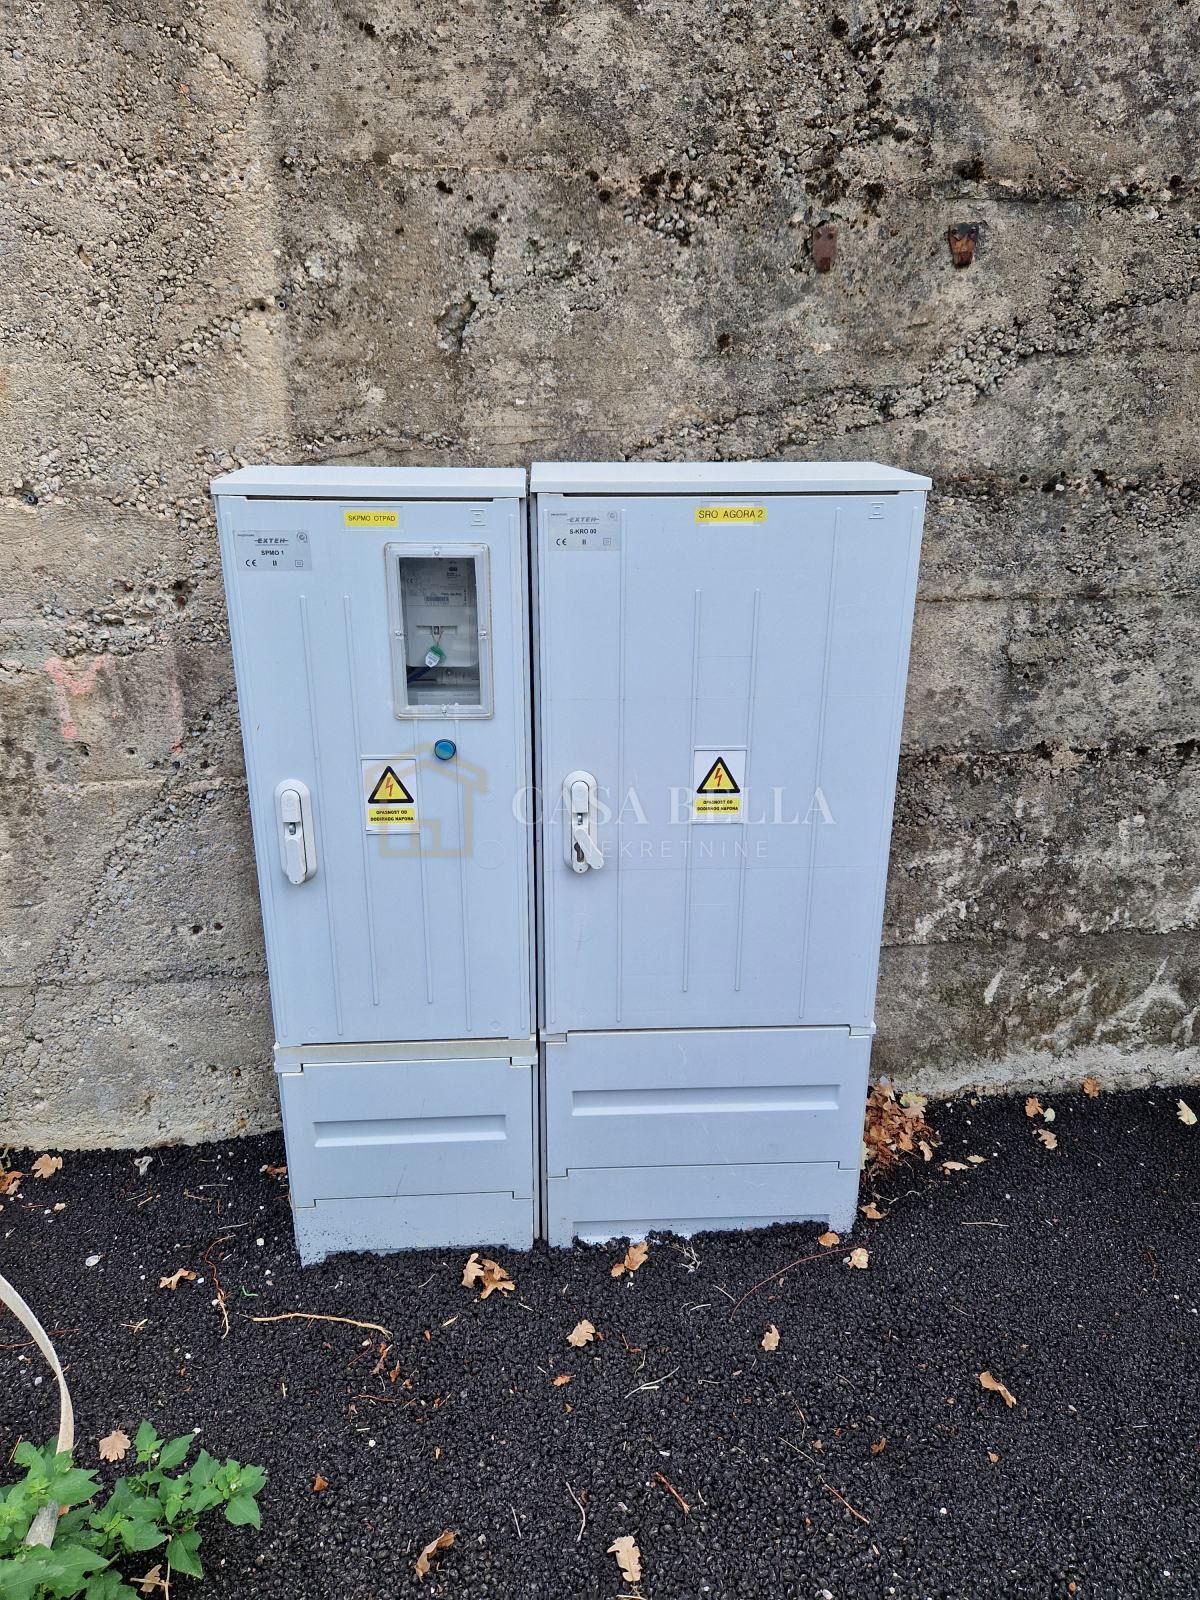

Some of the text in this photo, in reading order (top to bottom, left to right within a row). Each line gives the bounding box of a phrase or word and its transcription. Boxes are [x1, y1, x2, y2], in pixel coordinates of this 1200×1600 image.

[348, 514, 371, 522] SKPMO
[698, 509, 763, 519] SRO AGORA 2
